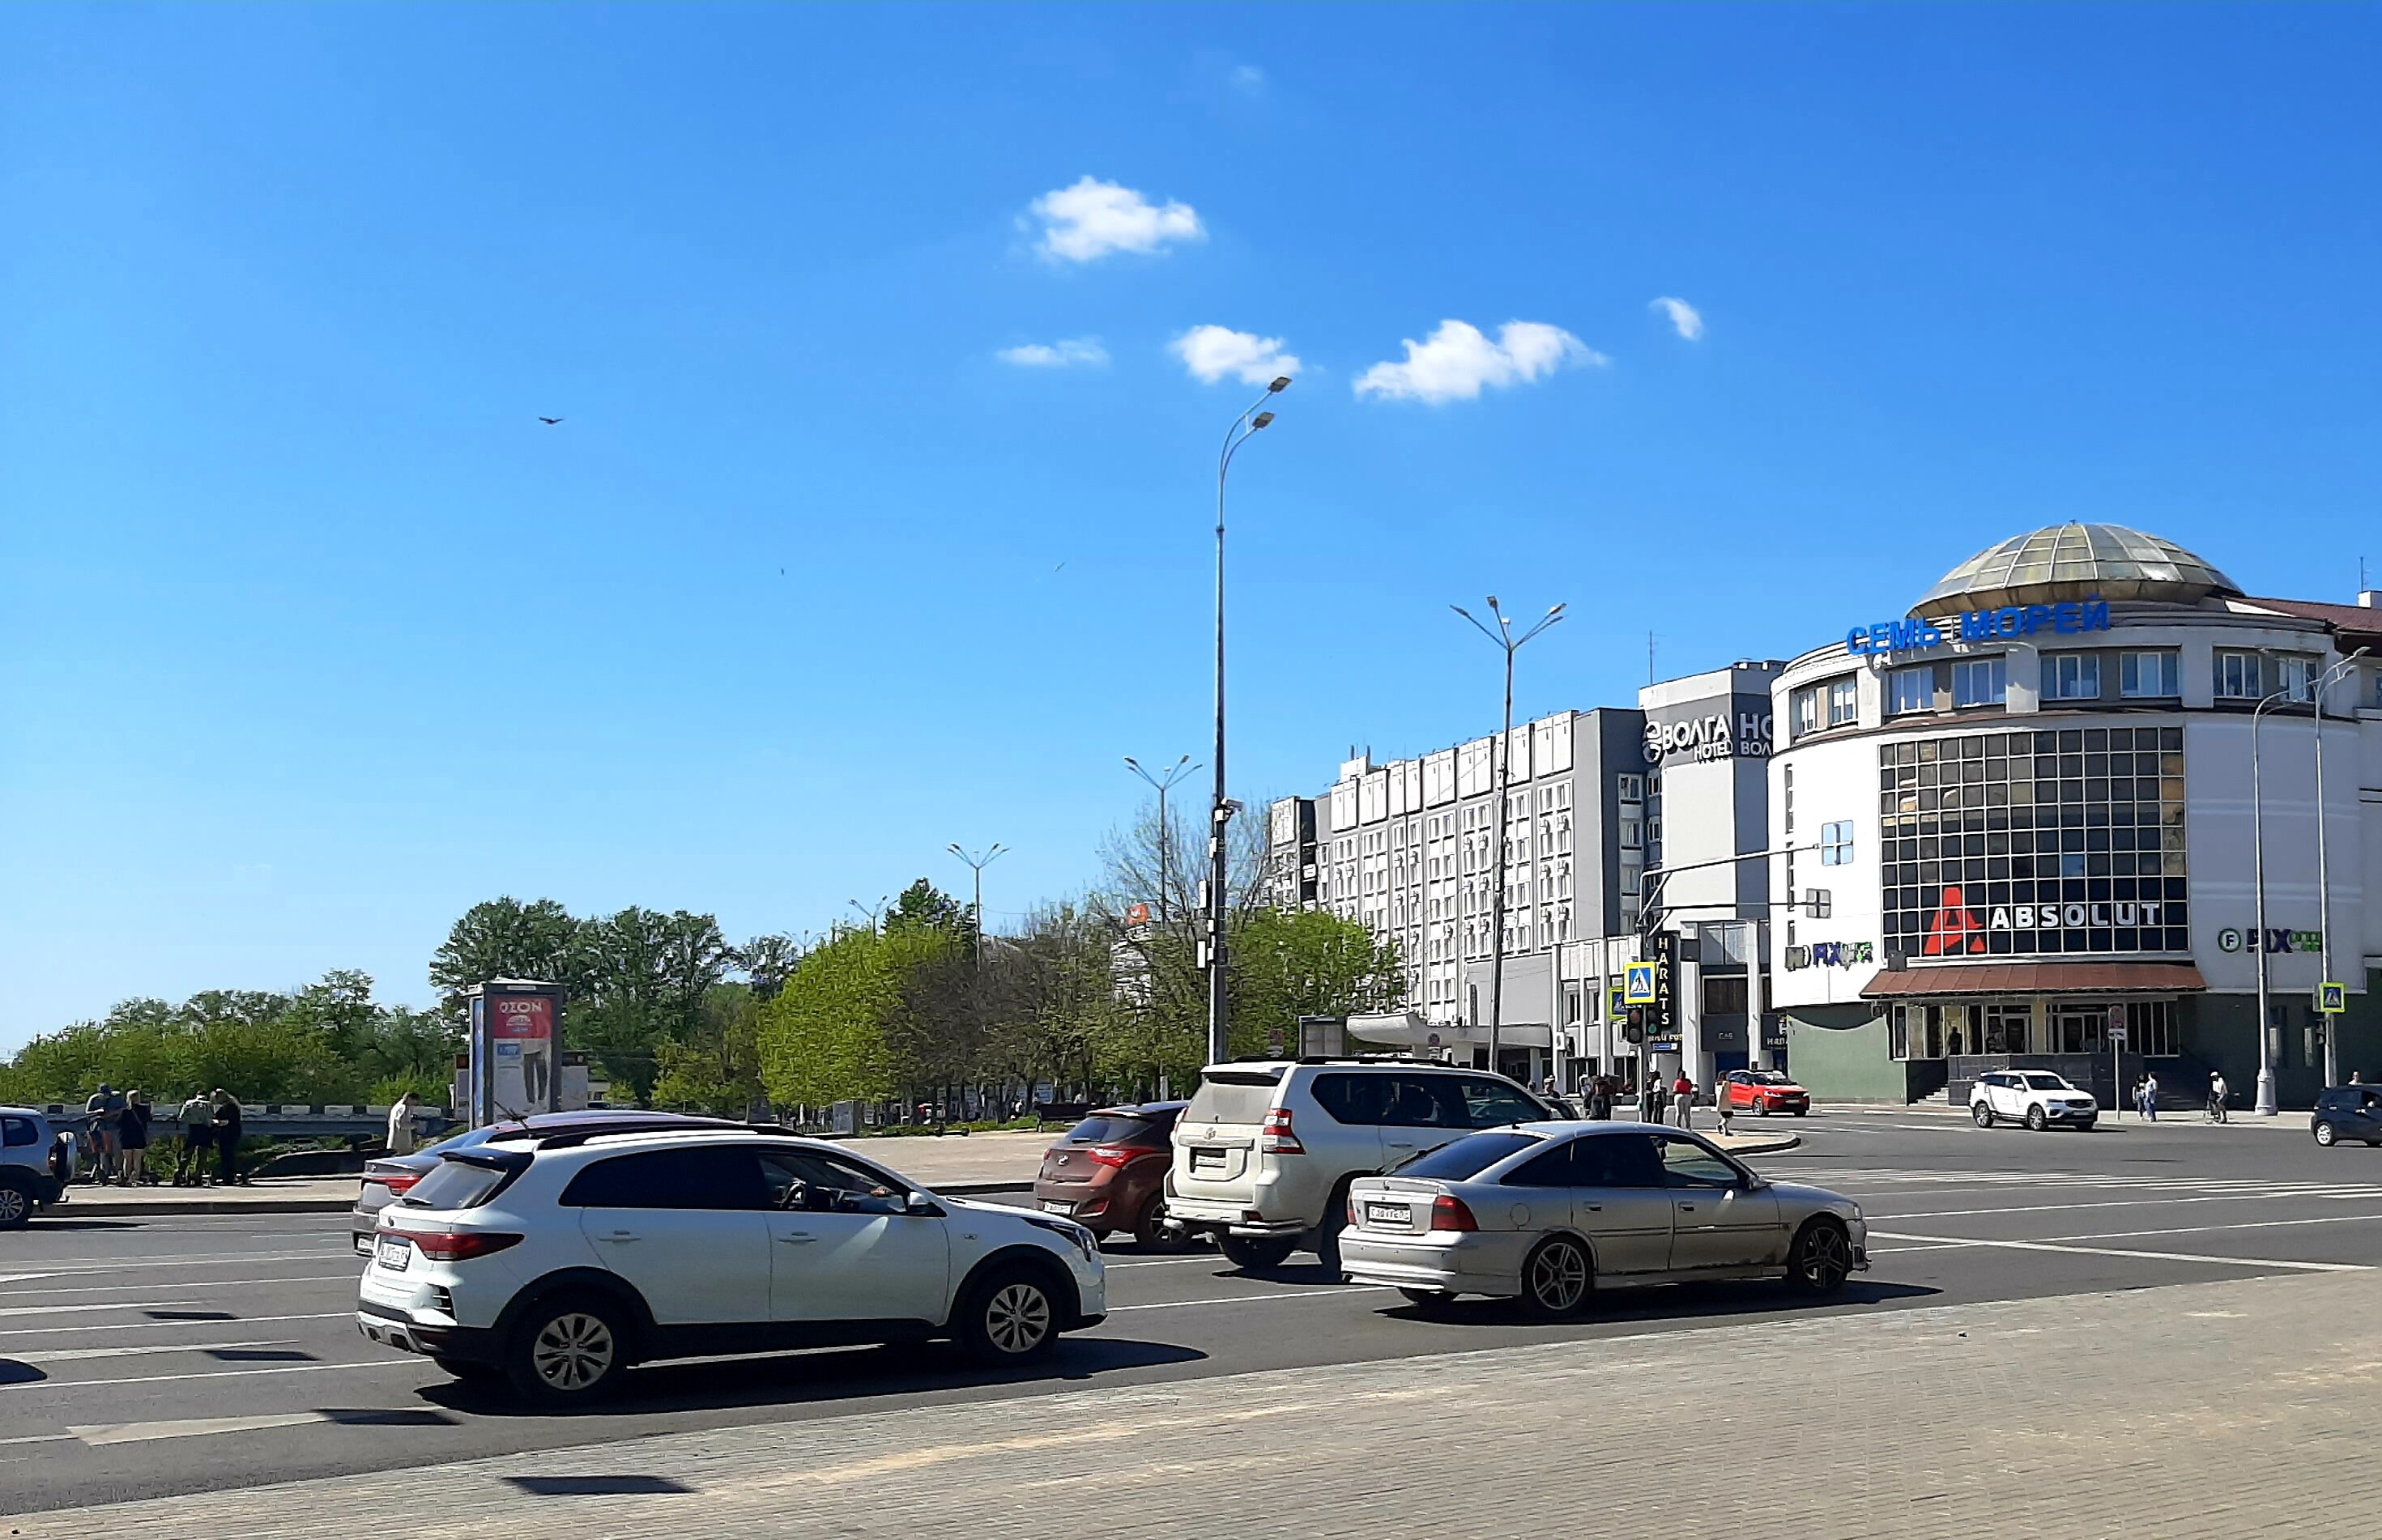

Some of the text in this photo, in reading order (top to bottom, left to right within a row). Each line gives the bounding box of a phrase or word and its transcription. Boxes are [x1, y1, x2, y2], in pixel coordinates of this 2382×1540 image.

[1847, 593, 2109, 655] СЕМЬ МОРЕЙ
[1663, 714, 1731, 750] ВОЛГА
[1694, 739, 1733, 760] HOTEL
[1991, 903, 2160, 929] ABSOLUT
[1658, 937, 1669, 1025] HARATS
